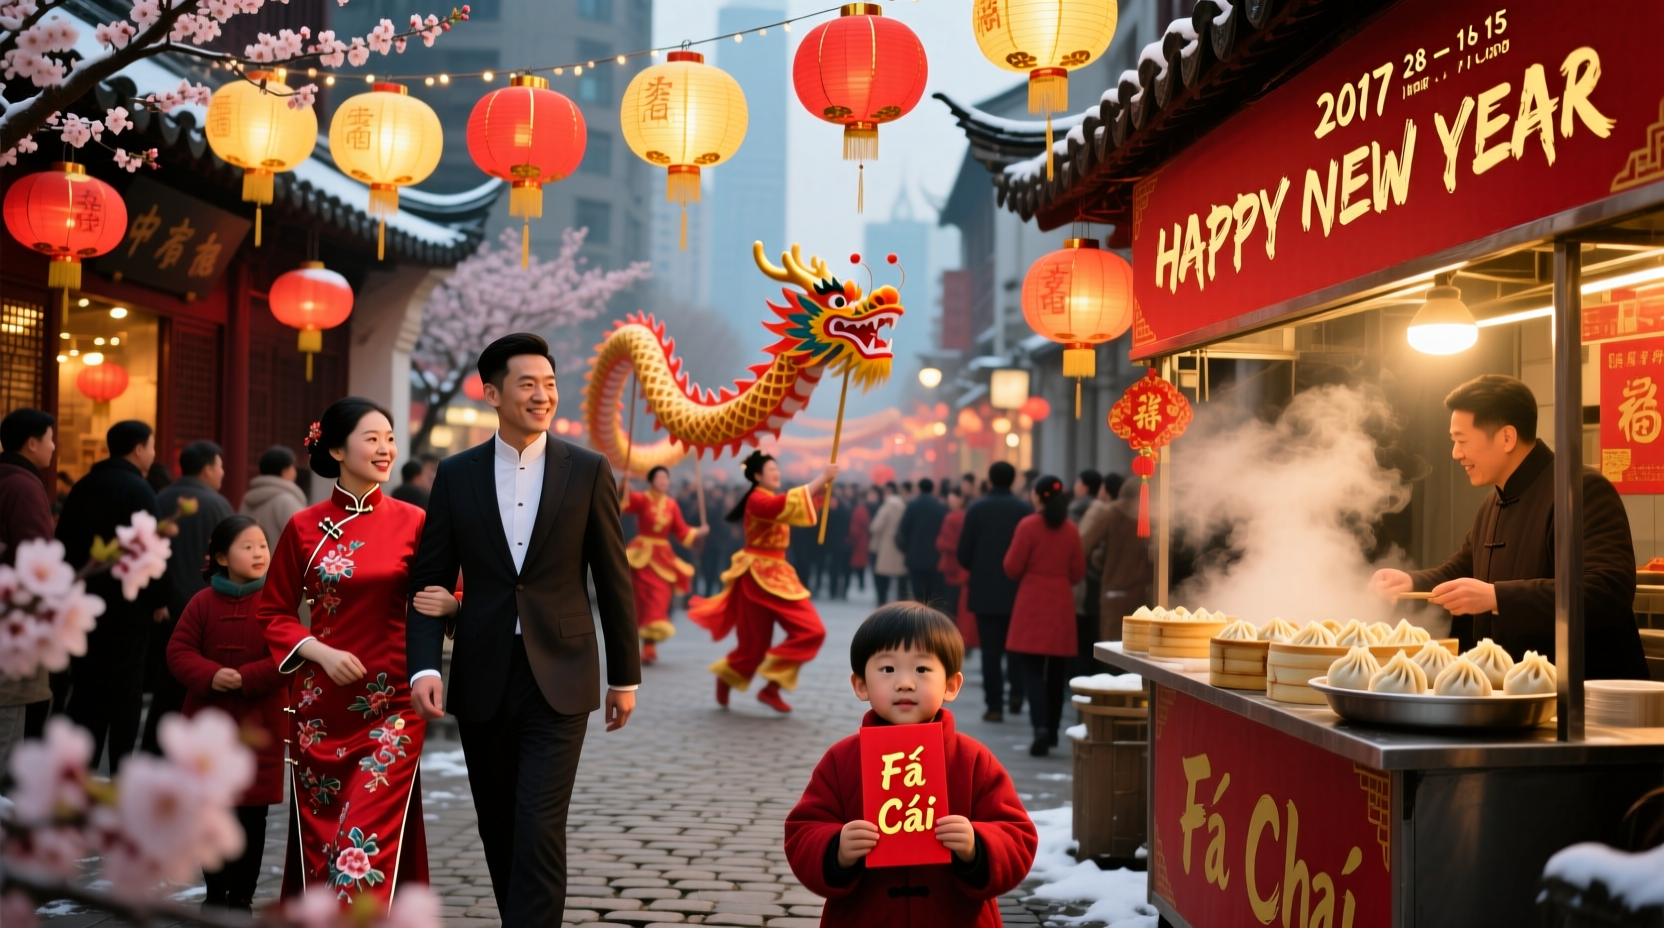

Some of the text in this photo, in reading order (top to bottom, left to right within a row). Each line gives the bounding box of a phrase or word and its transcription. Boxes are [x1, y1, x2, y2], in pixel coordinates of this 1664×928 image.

[1402, 47, 1427, 79] 28
[1456, 24, 1479, 52] 16
[1484, 8, 1508, 39] 15
[1313, 61, 1394, 140] 2017
[1155, 176, 1291, 295] HAPPY
[1301, 118, 1418, 238] NEW
[1433, 46, 1617, 194] YEAR
[1617, 376, 1663, 444] 福
[881, 745, 927, 791] Fá
[878, 793, 937, 835] Cái
[1179, 753, 1231, 891] Fá
